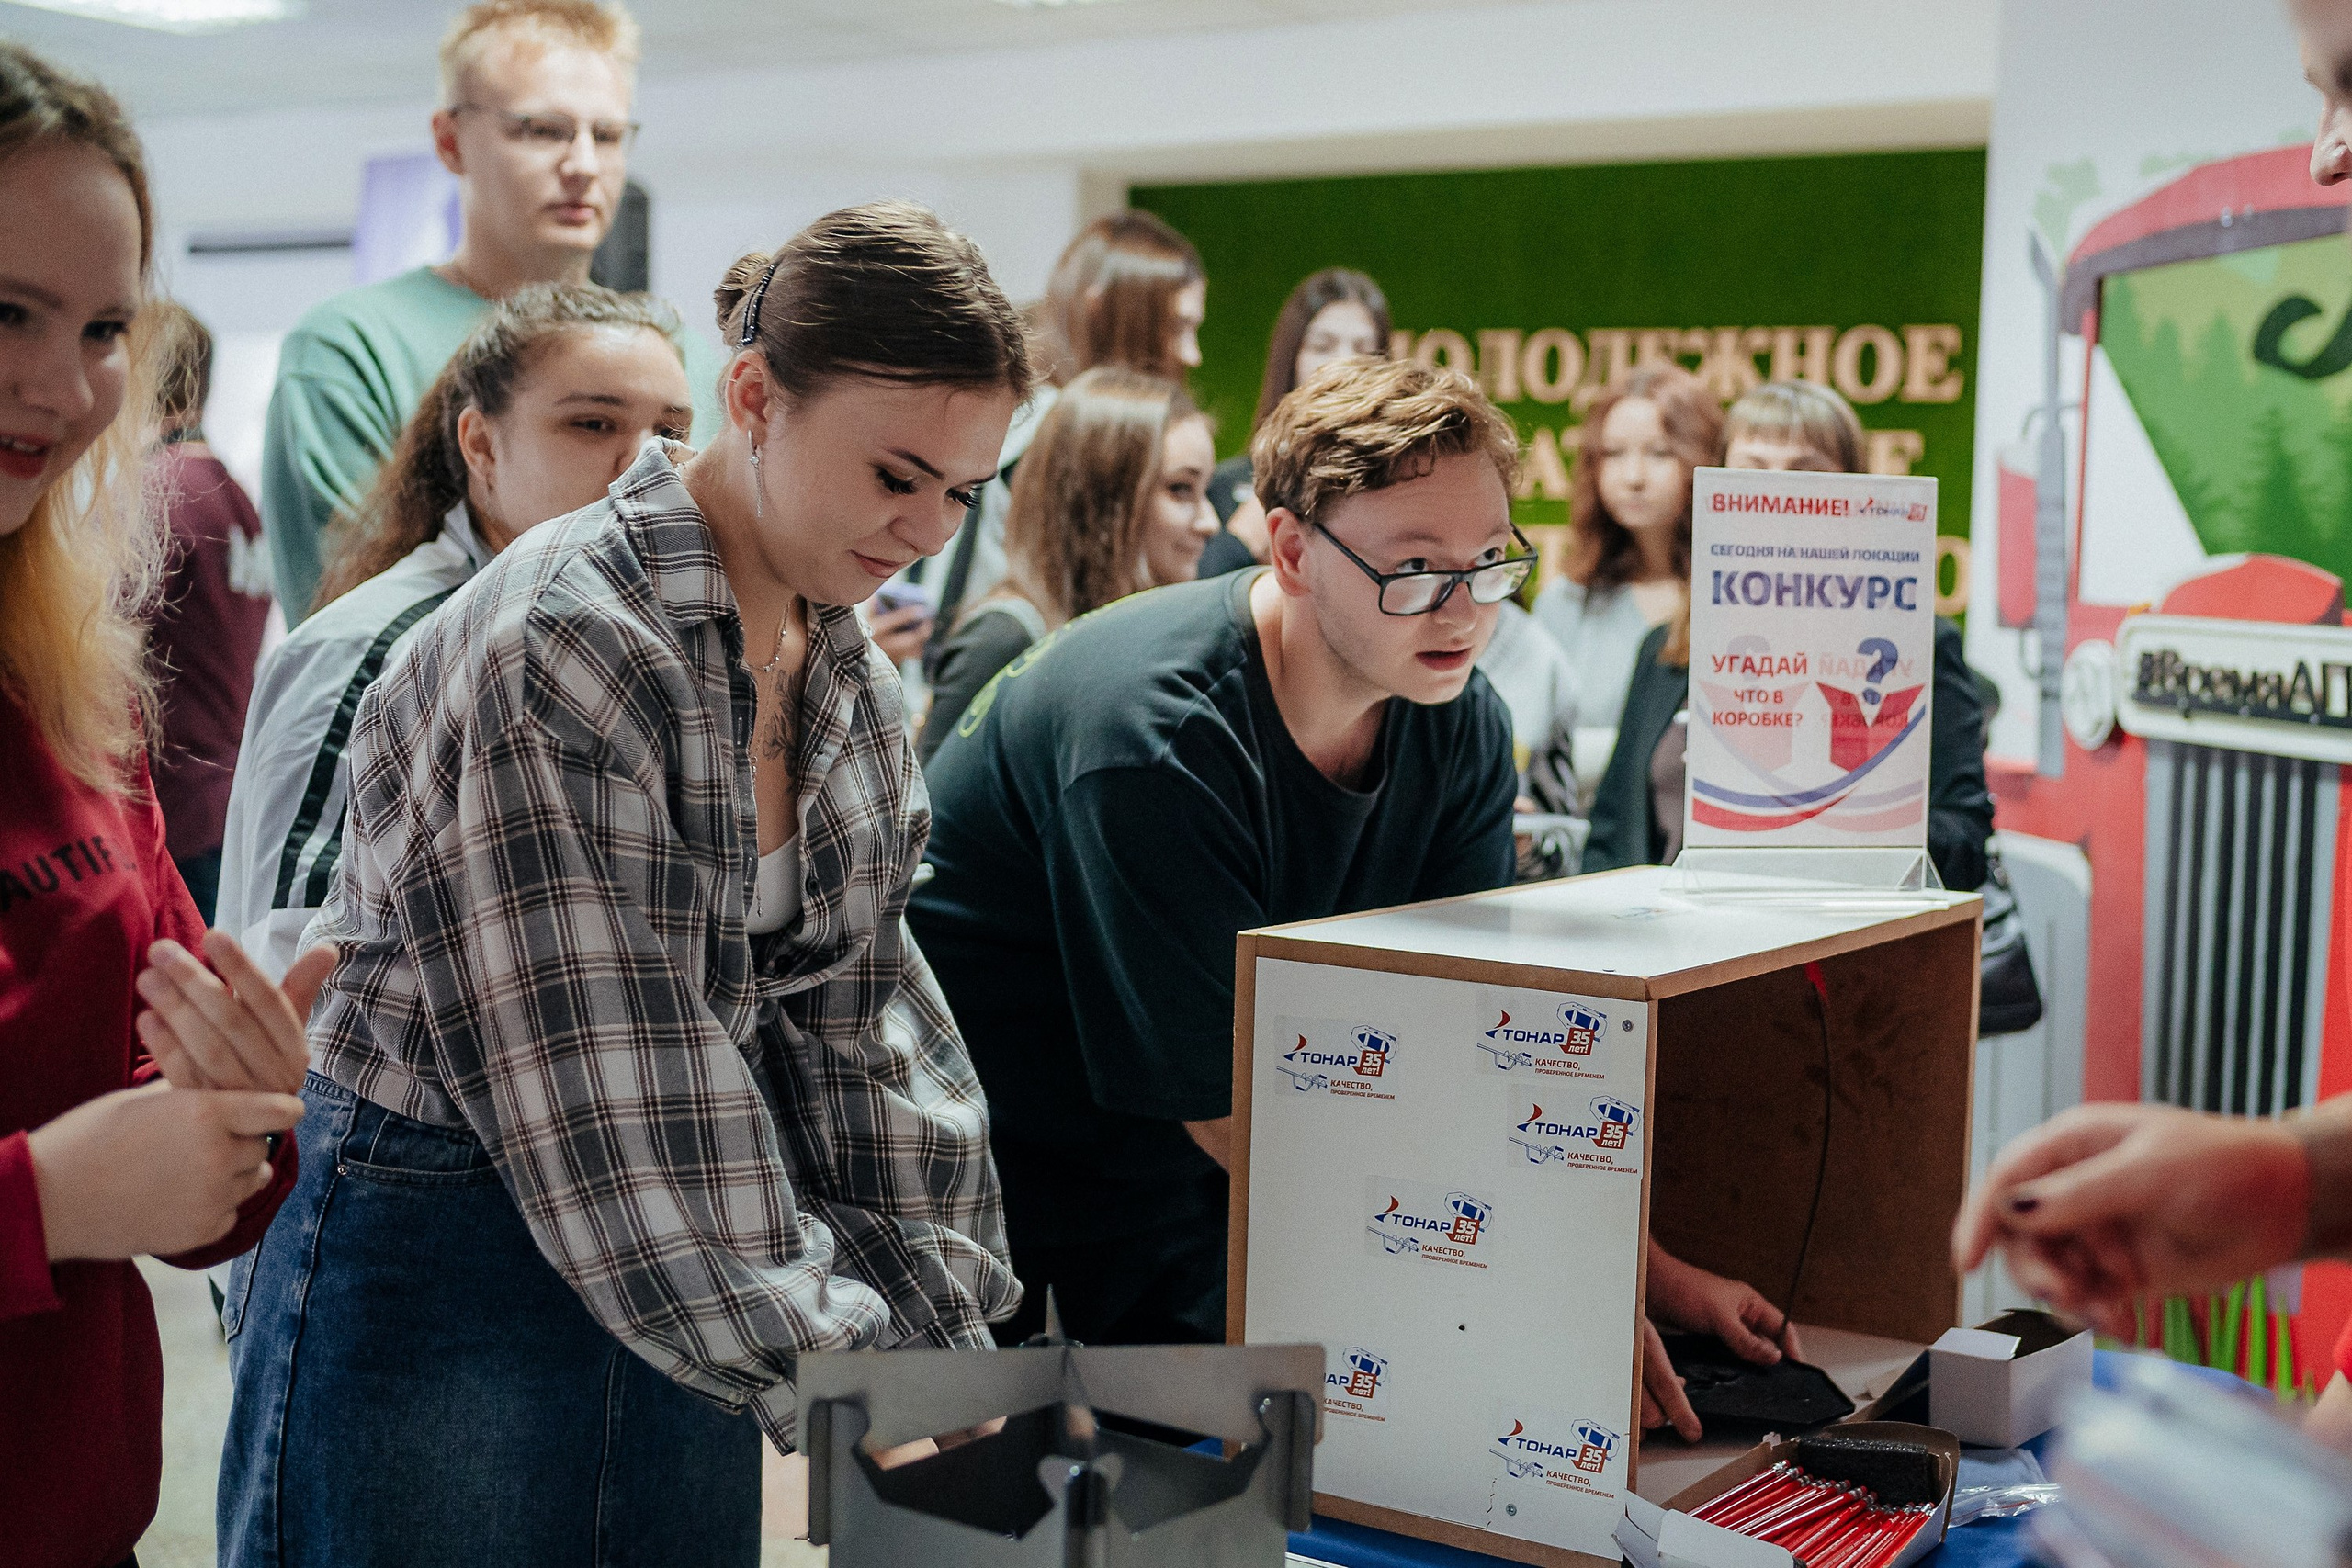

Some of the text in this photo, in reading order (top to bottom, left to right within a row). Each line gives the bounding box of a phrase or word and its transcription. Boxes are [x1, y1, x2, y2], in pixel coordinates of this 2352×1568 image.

[1713, 493, 1849, 516] ВНИМАНИЕ!
[1710, 544, 1919, 562] СЕГОДНЯ НА НАШЕЙ ЛОКАЦИИ
[1711, 570, 1917, 611] КОНКУРС
[1712, 652, 1808, 677] УГАДАЙ
[1734, 689, 1783, 704] ЧТО В
[1712, 711, 1803, 728] КОРОБКЕ?
[1502, 1029, 1565, 1044] ТОНАР
[1570, 1030, 1590, 1045] 35
[1568, 1045, 1588, 1054] лет!
[1300, 1052, 1358, 1066] ТОНАР
[1363, 1052, 1382, 1066] 35
[1534, 1058, 1580, 1070] КАЧЕСТВО,
[1362, 1066, 1379, 1075] лет!
[1534, 1068, 1574, 1077] ПРОВЕРЕННОЕ
[1330, 1079, 1373, 1091] КАЧЕСТВО,
[1534, 1122, 1598, 1138] ТОНАР
[1603, 1123, 1623, 1139] 35
[1601, 1139, 1621, 1147] лет!
[1567, 1152, 1613, 1165] КАЧЕСТВО,
[1567, 1162, 1606, 1171] ПРОВЕРЕННОЕ
[1392, 1214, 1451, 1232] ТОНАР
[1456, 1219, 1476, 1235] 35
[1454, 1235, 1474, 1243] лет!
[1421, 1244, 1465, 1258] КАЧЕСТВО,
[1421, 1254, 1458, 1264] ПРОВЕРЕННОЕ
[1323, 1372, 1350, 1385] АР
[1354, 1373, 1374, 1389] 35
[1351, 1388, 1371, 1396] лет!
[1516, 1438, 1577, 1459] ТОНАР
[1582, 1447, 1603, 1463] 35
[1579, 1462, 1600, 1472] лет!
[1546, 1470, 1591, 1487] КАЧЕСТВО,
[1545, 1480, 1584, 1492] ПРОВЕРЕННОЕ
